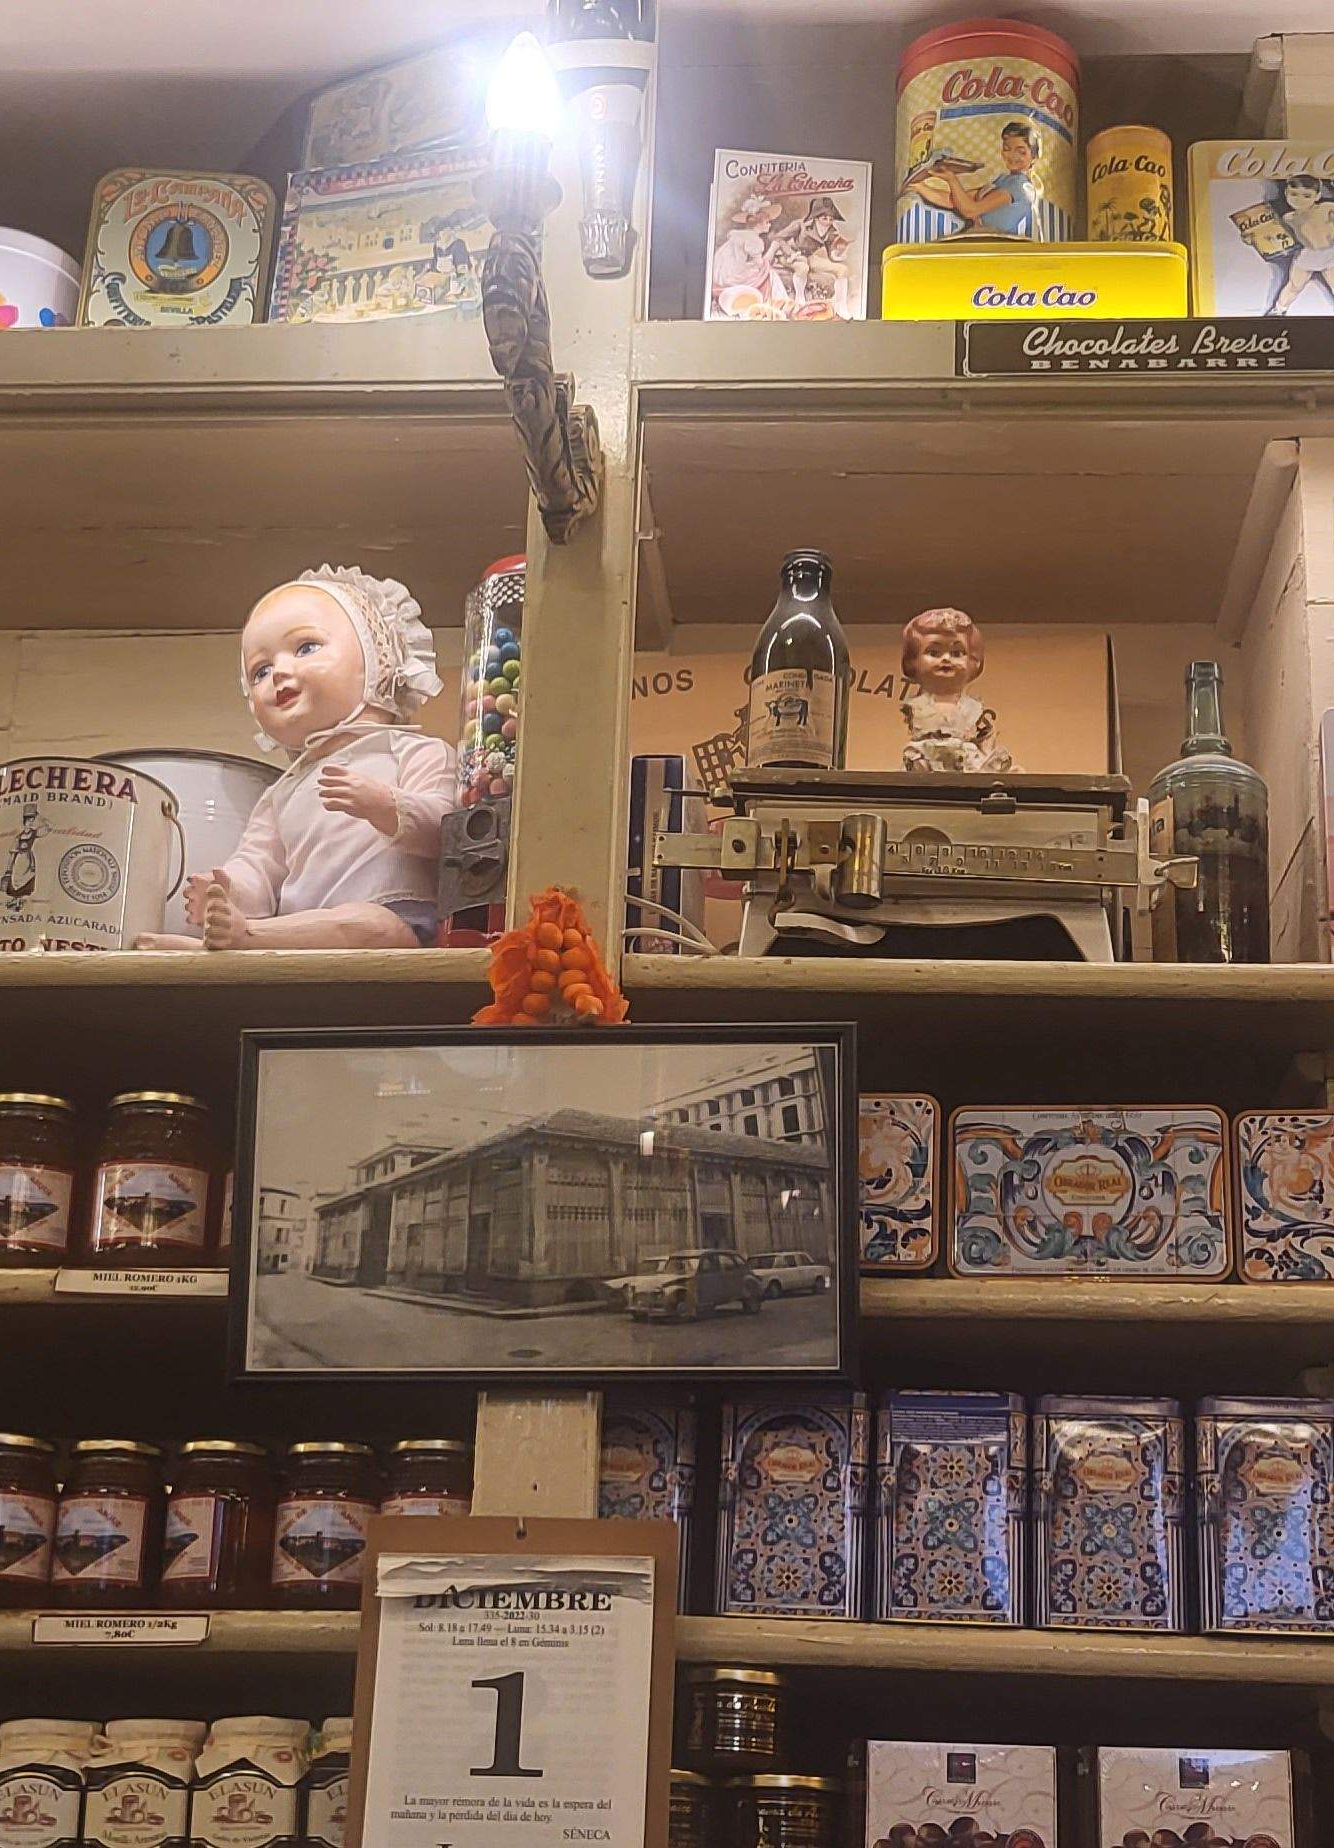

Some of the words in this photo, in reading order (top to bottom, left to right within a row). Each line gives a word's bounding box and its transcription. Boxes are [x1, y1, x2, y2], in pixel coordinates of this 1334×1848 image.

[725, 159, 806, 179] CONFITERIA
[971, 284, 1037, 308] Cola
[1041, 284, 1098, 308] Cao
[1022, 325, 1179, 356] Chocolates
[1190, 324, 1291, 354] Brescó
[1029, 357, 1287, 370] BENABARRE
[93, 1272, 122, 1282] MIEL
[122, 1273, 174, 1283] ROMERO
[65, 1619, 93, 1629] MIEL
[96, 1620, 145, 1629] ROMERO
[468, 1623, 493, 1633] 17.49
[536, 1624, 560, 1634] 15.34
[591, 1624, 605, 1636] (2)
[500, 1636, 509, 1646] el
[511, 1636, 516, 1646] 8
[469, 1671, 544, 1778] 1
[404, 1795, 417, 1806] La
[419, 1798, 449, 1808] mayor
[488, 1797, 501, 1807] de
[503, 1797, 512, 1807] la
[516, 1797, 536, 1808] vida
[539, 1800, 549, 1809] es
[552, 1798, 560, 1809] la
[563, 1800, 594, 1812] espera
[597, 1799, 612, 1810] del
[429, 1812, 435, 1822] y
[438, 1810, 447, 1820] la
[486, 1811, 501, 1822] del
[520, 1811, 532, 1822] de
